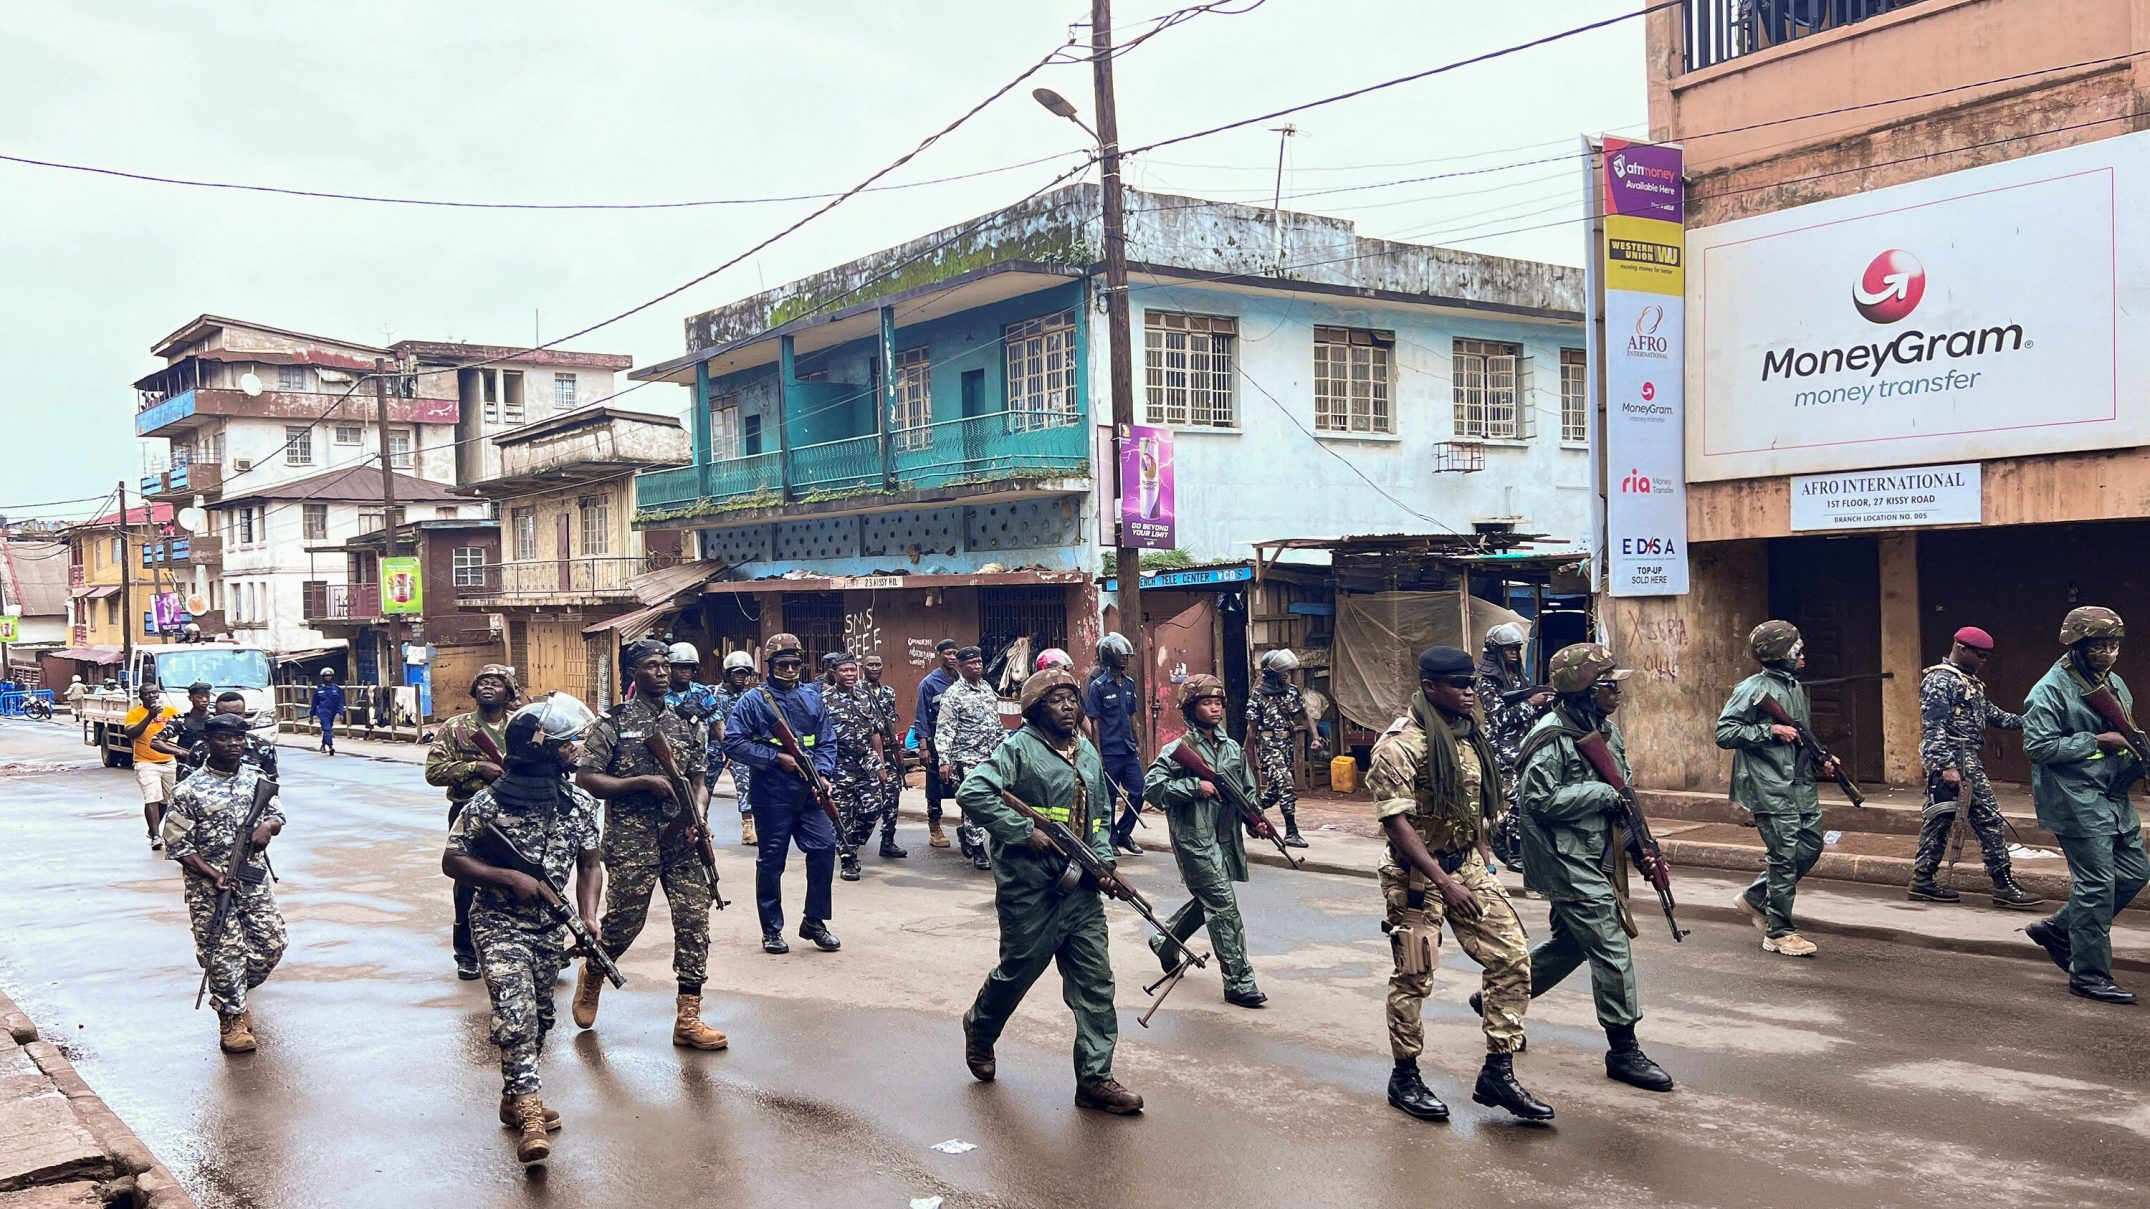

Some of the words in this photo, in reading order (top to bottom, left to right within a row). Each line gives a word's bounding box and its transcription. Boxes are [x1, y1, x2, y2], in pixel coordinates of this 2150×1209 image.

[1626, 180, 1659, 193] Available
[1659, 184, 1676, 196] Here
[1611, 241, 1653, 253] WESTERN
[1625, 251, 1653, 261] UNION
[1654, 246, 1678, 265] WU
[1620, 264, 1638, 272] moving
[1628, 335, 1667, 353] AFRO
[1627, 350, 1668, 360] INTERNATIONAL
[1794, 383, 1875, 407] money
[1878, 369, 1982, 398] transfer
[1629, 416, 1647, 424] money
[1647, 416, 1666, 424] transfer
[1622, 468, 1650, 493] ria
[1652, 477, 1672, 487] Money
[1802, 480, 1839, 496] AFRO
[1843, 472, 1965, 494] INTERNATIONAL
[1652, 485, 1674, 494] Transfer
[1827, 500, 1840, 509] 1ST
[1842, 498, 1871, 508] FLOOR,
[1874, 497, 1883, 506] 27
[1886, 496, 1909, 505] KISSY
[1911, 495, 1936, 504] ROAD
[1834, 515, 1862, 523] BRANCH
[1863, 514, 1898, 522] LOCATION
[1914, 512, 1928, 520] 005
[1131, 522, 1141, 530] GO
[1142, 523, 1169, 532] BEYOND
[1132, 529, 1150, 537] YOUR
[1151, 530, 1169, 539] LIMIT
[1637, 566, 1663, 575] TOP-UP
[865, 578, 873, 587] 23
[1140, 576, 1156, 587] ENCH
[1162, 574, 1177, 585] TELE
[1182, 571, 1210, 584] CENTER
[1631, 576, 1649, 585] SOLD
[1650, 575, 1667, 584] HERE
[845, 608, 873, 635] SMS
